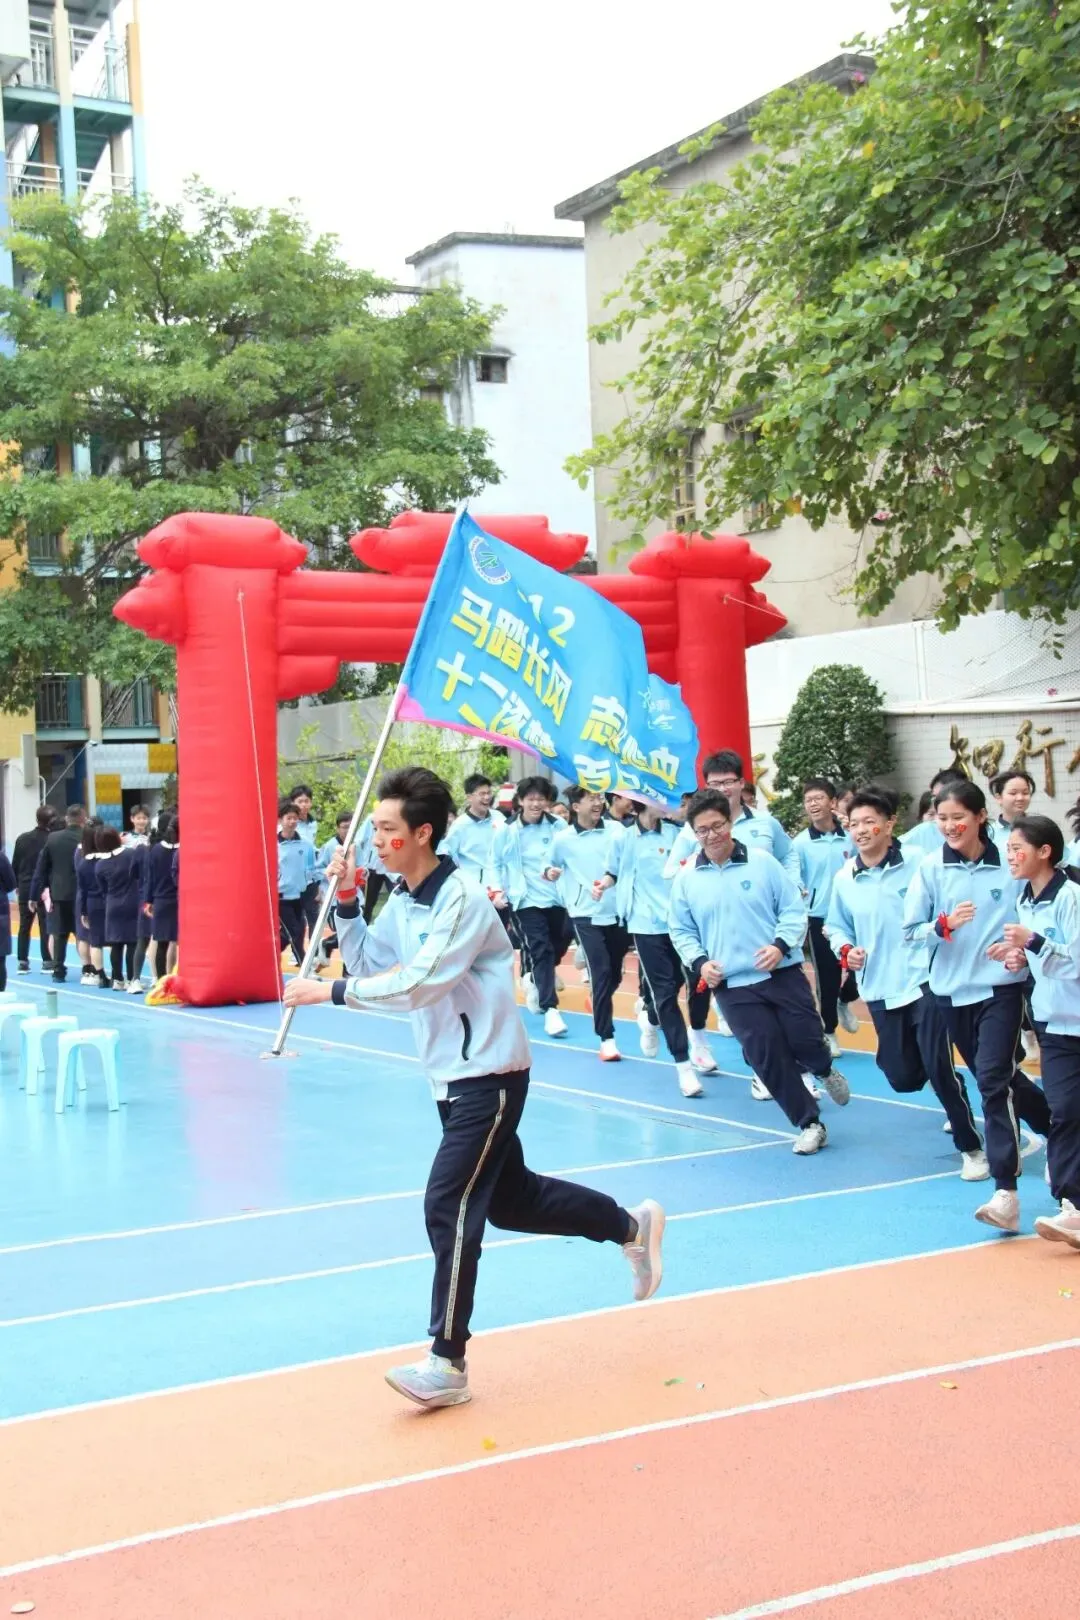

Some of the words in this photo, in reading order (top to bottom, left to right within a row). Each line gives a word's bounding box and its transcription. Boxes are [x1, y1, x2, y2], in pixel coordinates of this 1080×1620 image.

[451, 586, 573, 727] 马踏长风
[949, 719, 1080, 798] 知行
